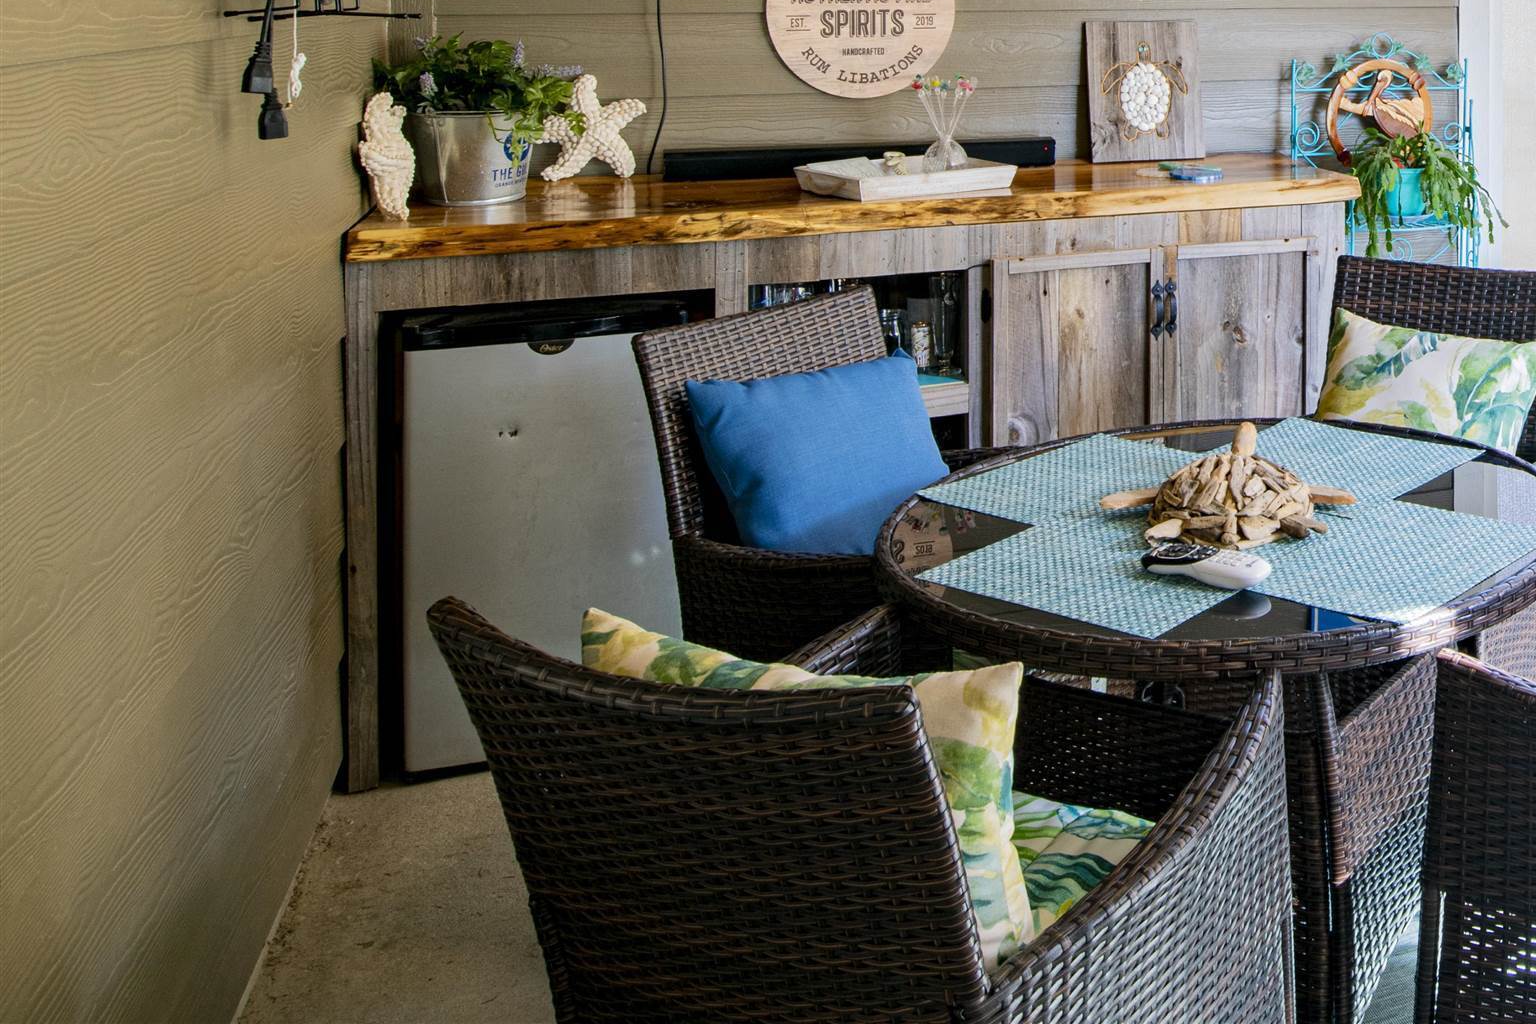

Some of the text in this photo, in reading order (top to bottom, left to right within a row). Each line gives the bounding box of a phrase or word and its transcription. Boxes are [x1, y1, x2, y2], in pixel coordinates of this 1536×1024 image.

[790, 18, 807, 28] EST.
[820, 8, 905, 38] SPIRITS
[915, 16, 934, 26] 2019
[842, 47, 885, 56] HANDCRAFTED
[801, 44, 924, 84] RUM LIBATIONS
[492, 167, 513, 181] THE
